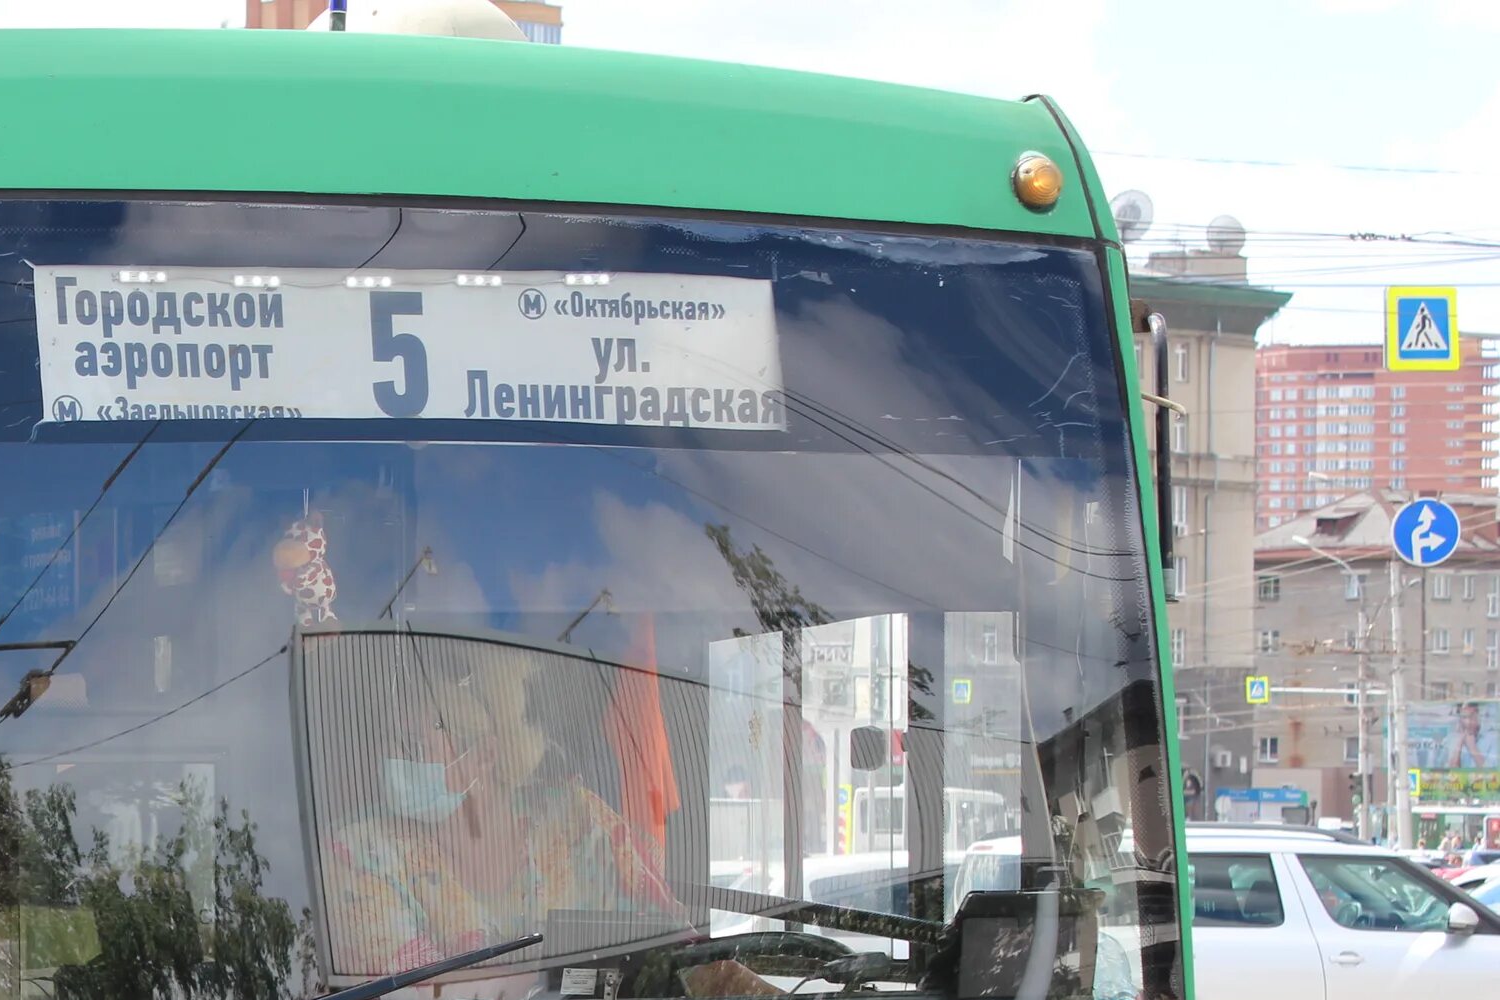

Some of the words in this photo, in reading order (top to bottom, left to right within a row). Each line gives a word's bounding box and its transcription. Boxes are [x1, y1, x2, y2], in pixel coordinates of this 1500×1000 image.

[55, 277, 284, 338] Городской
[553, 291, 727, 326] «Октябрьская»
[74, 341, 274, 392] аэропорт
[369, 291, 429, 419] 5
[590, 337, 651, 384] ул.
[463, 370, 781, 428] Ленинградская
